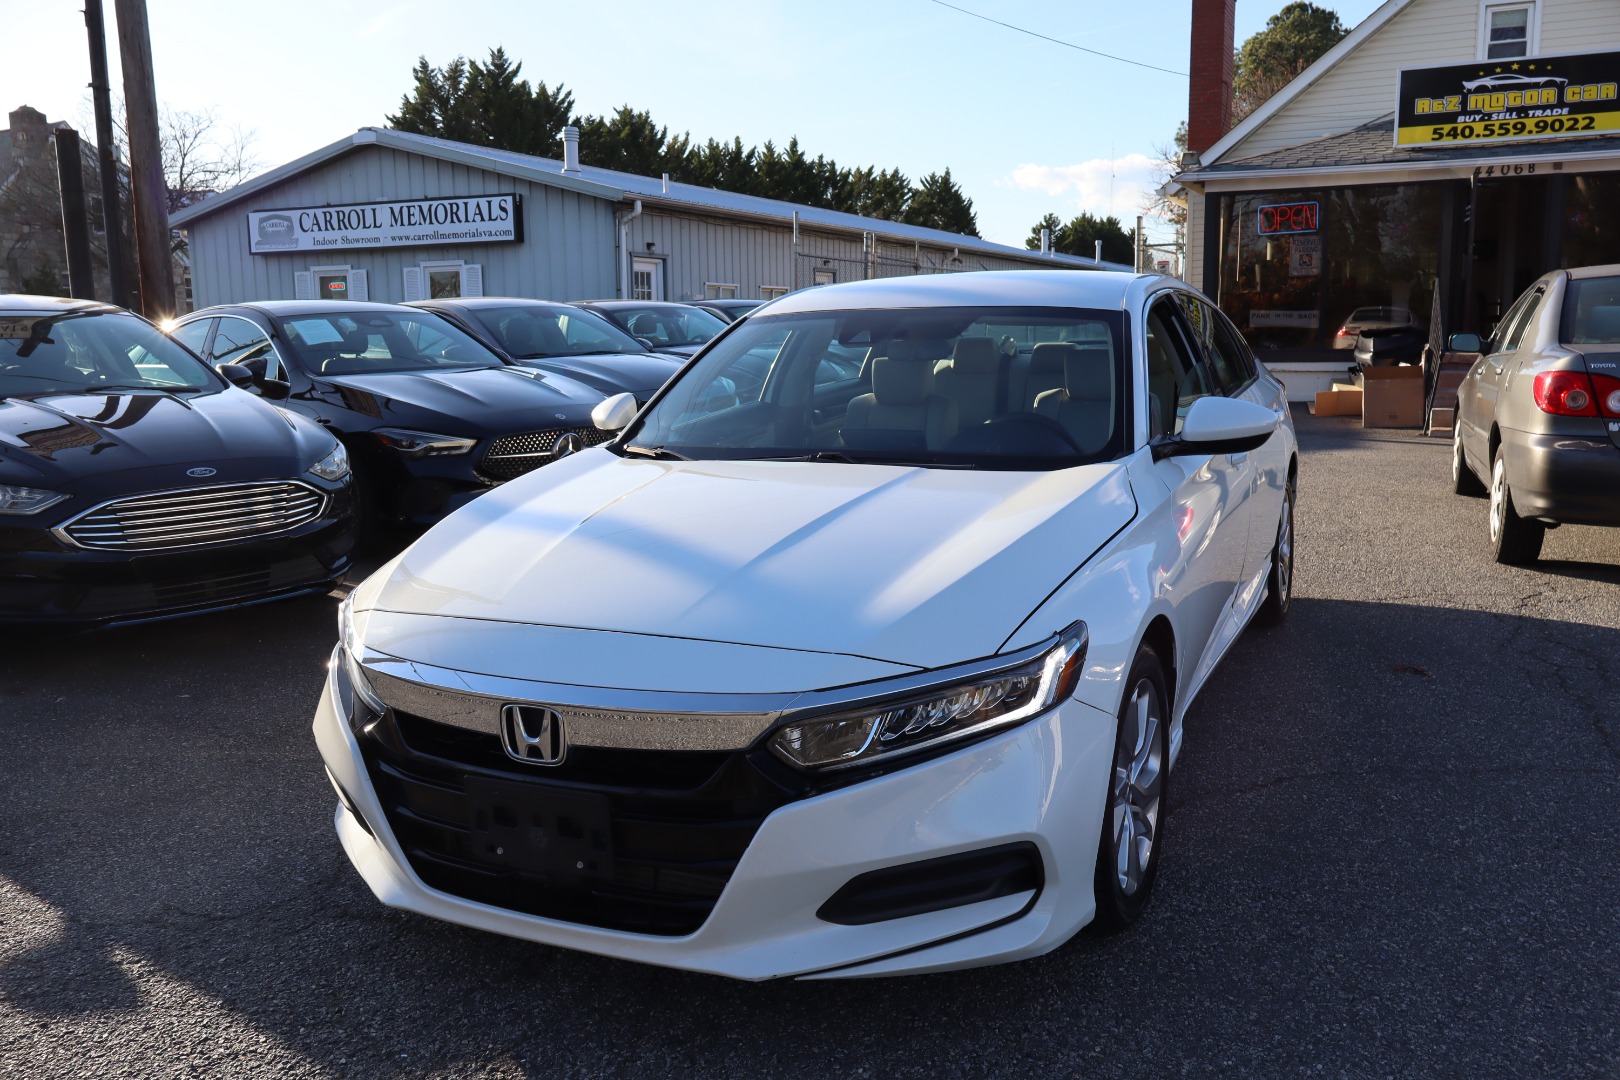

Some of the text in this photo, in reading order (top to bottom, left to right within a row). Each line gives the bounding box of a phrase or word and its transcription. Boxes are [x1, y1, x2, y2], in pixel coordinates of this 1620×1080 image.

[1457, 107, 1570, 123] BUY SELL TRADE
[1431, 116, 1596, 141] 540.559.9022
[299, 198, 509, 233] CARROLL MEMORIALS
[1260, 204, 1317, 232] OPEN
[312, 228, 513, 246] Indoor Showroom www.carrollmemorialsva.com
